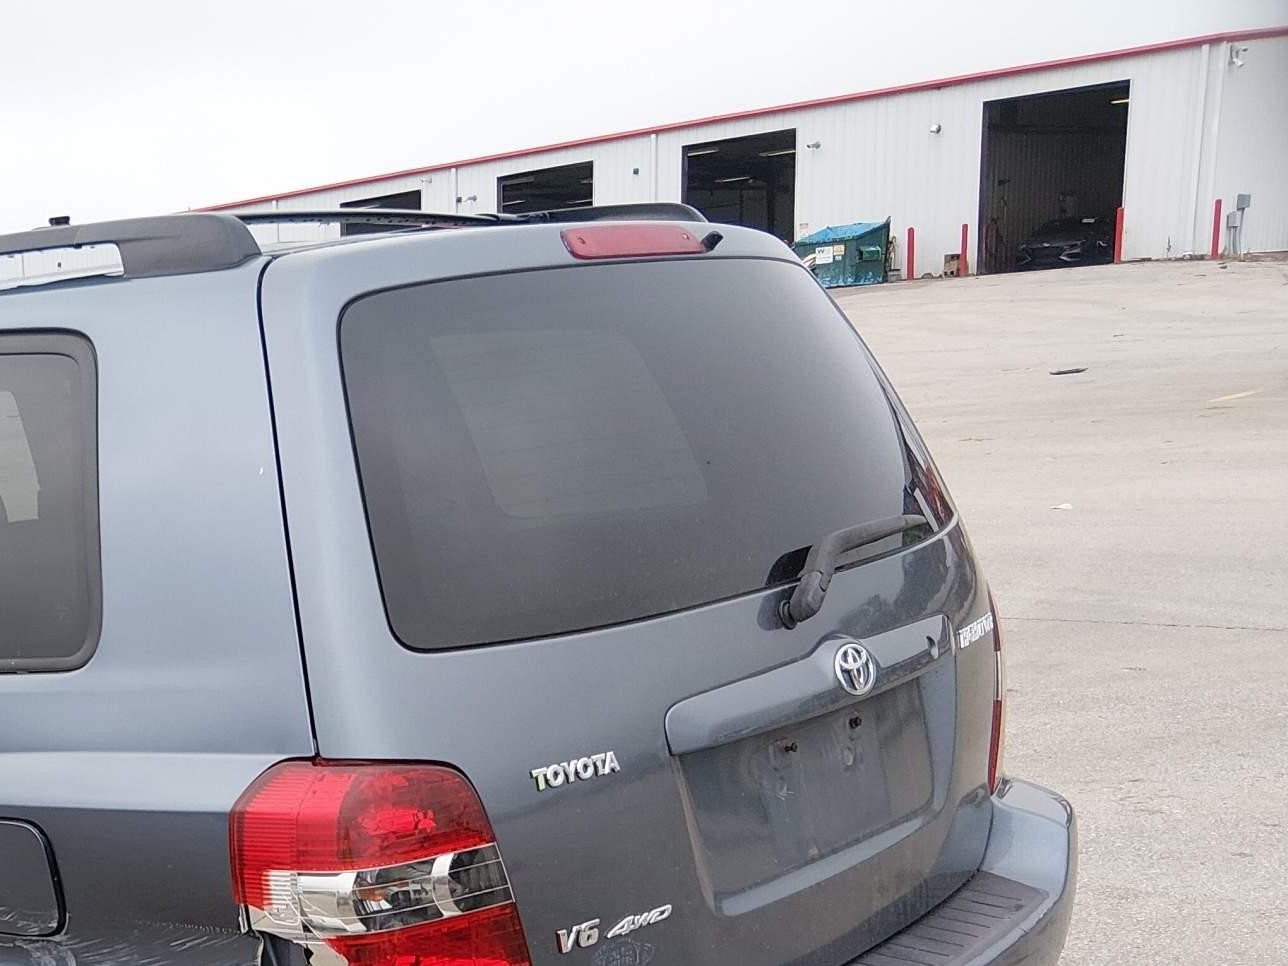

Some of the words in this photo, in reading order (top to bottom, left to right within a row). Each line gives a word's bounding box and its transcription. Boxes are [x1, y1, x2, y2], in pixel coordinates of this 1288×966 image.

[531, 751, 621, 792] TOYOTA
[556, 918, 600, 953] V6
[605, 904, 672, 938] 4WD
